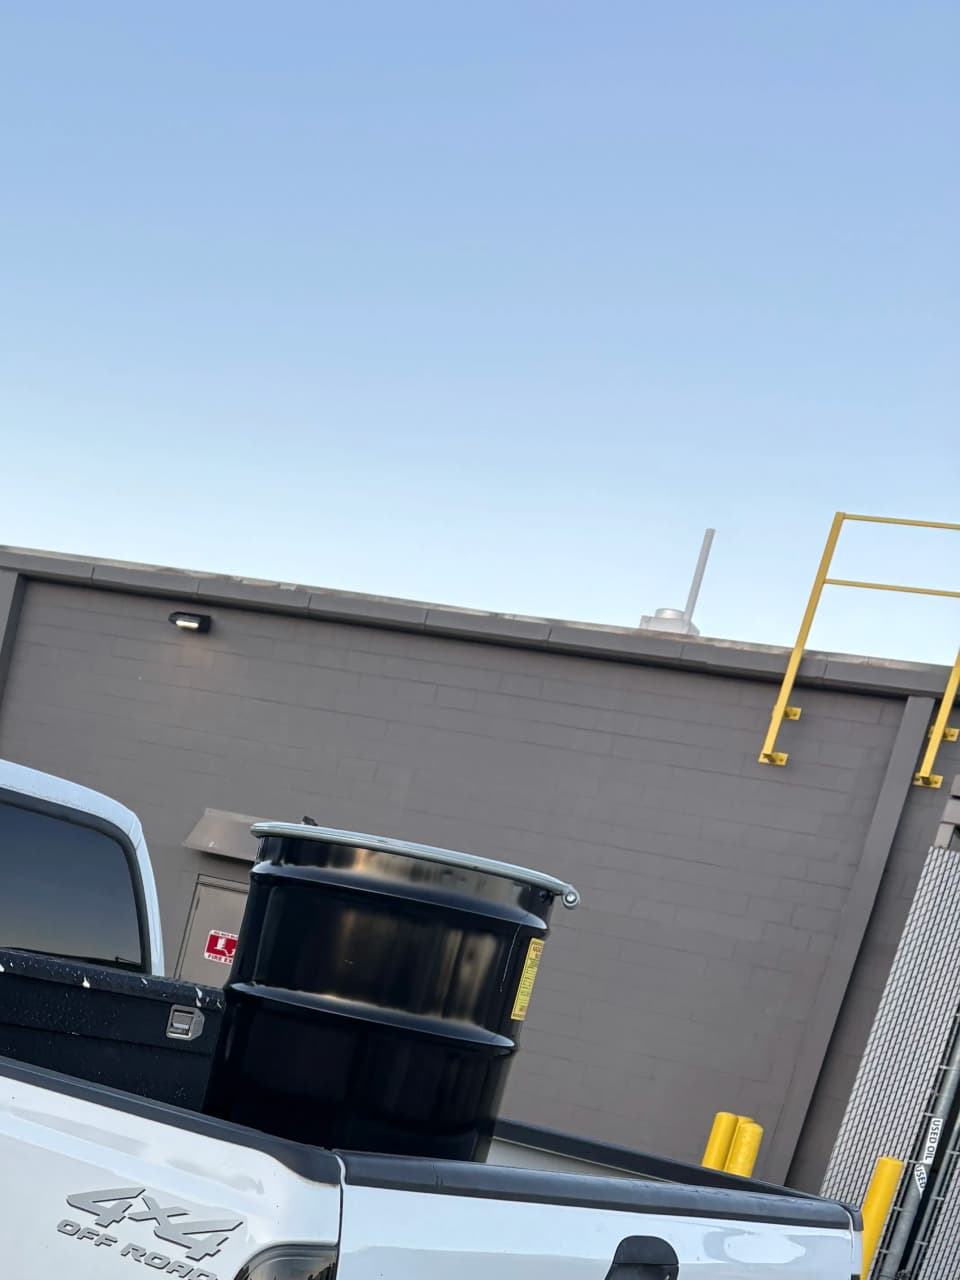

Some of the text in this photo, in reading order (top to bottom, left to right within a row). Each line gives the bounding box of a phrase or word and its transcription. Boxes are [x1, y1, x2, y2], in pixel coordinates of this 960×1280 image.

[924, 1119, 941, 1161] USED OIL
[56, 1219, 118, 1247] OFF
